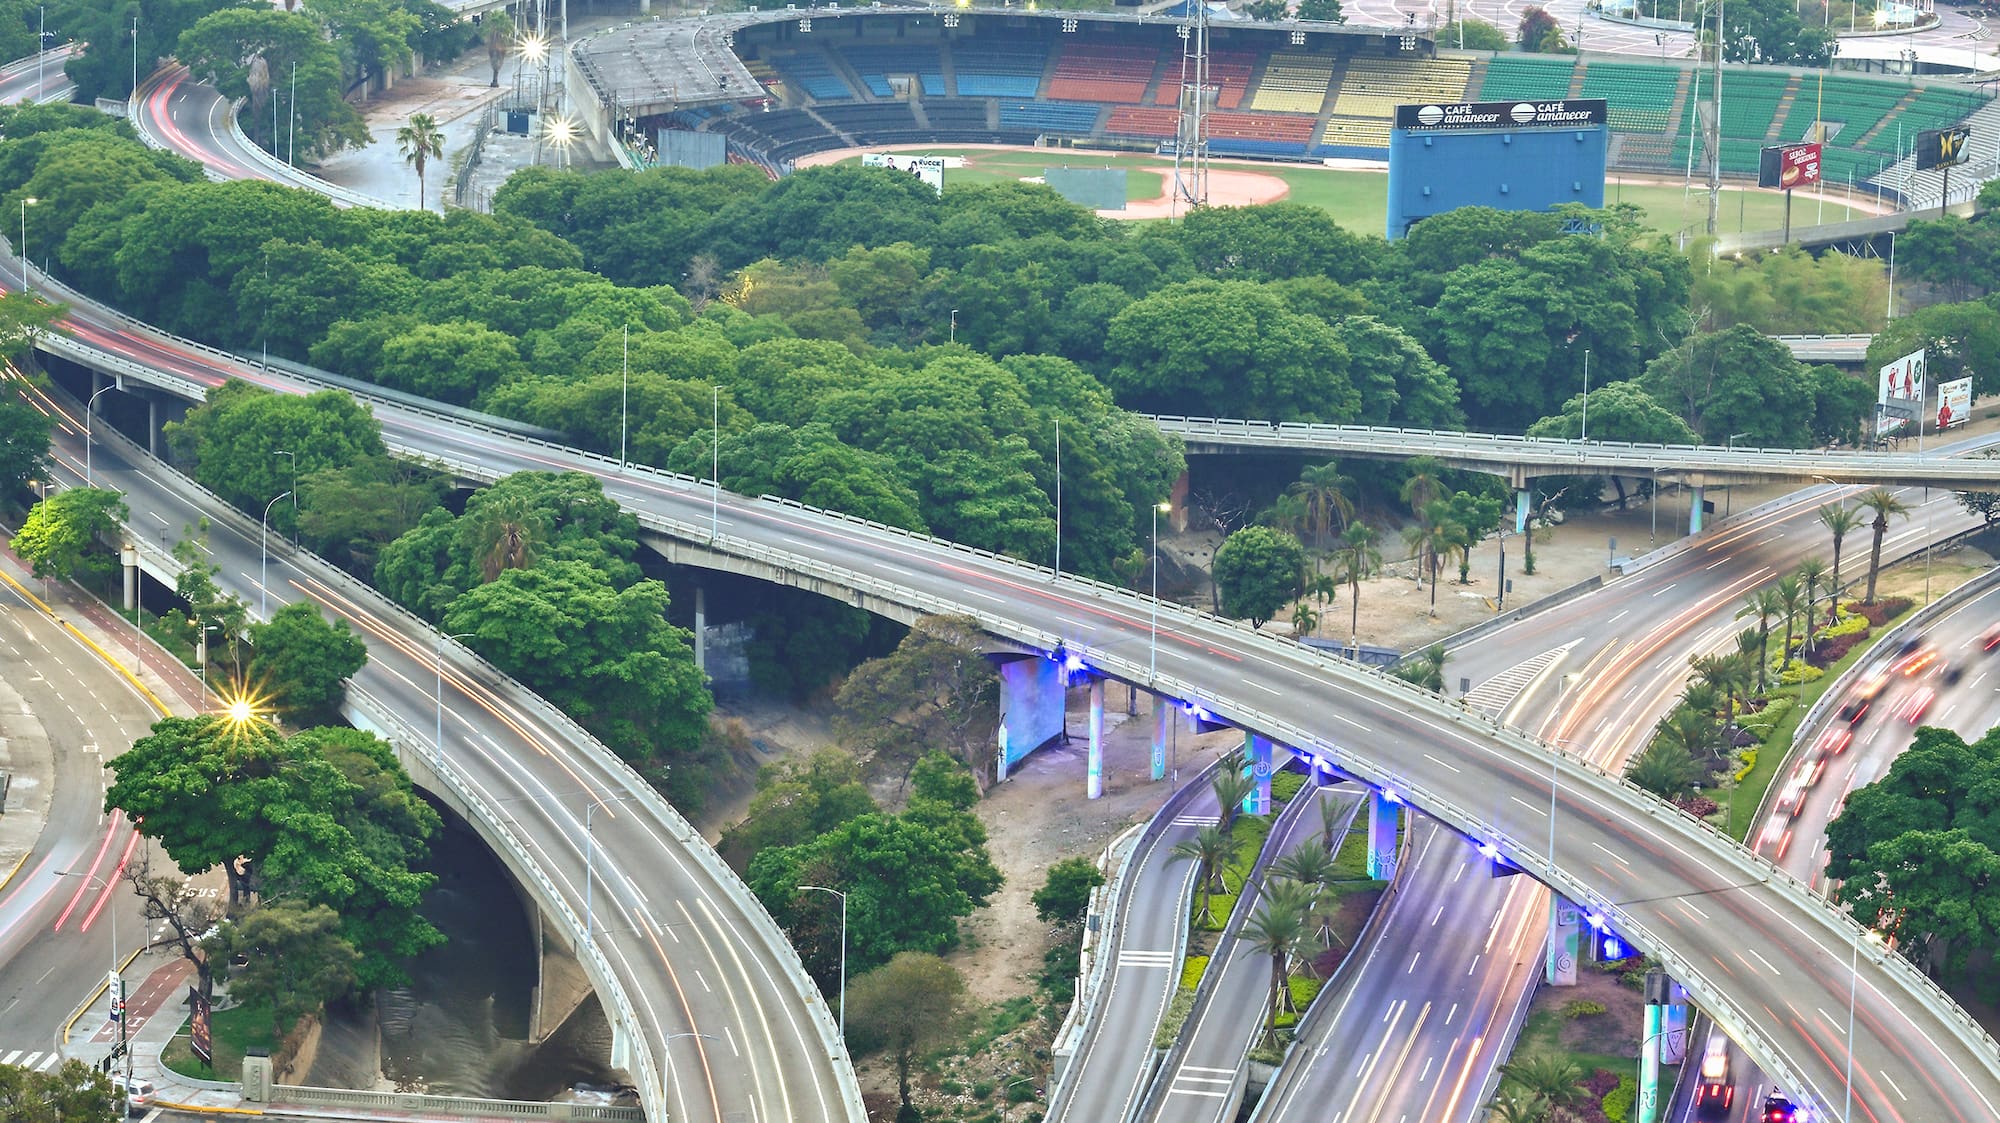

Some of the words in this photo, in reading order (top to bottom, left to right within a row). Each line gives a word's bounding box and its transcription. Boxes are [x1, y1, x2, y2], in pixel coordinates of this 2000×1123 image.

[1445, 103, 1473, 115] CAFÉ
[1537, 101, 1565, 113] CAFÉ
[1444, 112, 1500, 123] amanecer
[1537, 110, 1592, 121] amanecer
